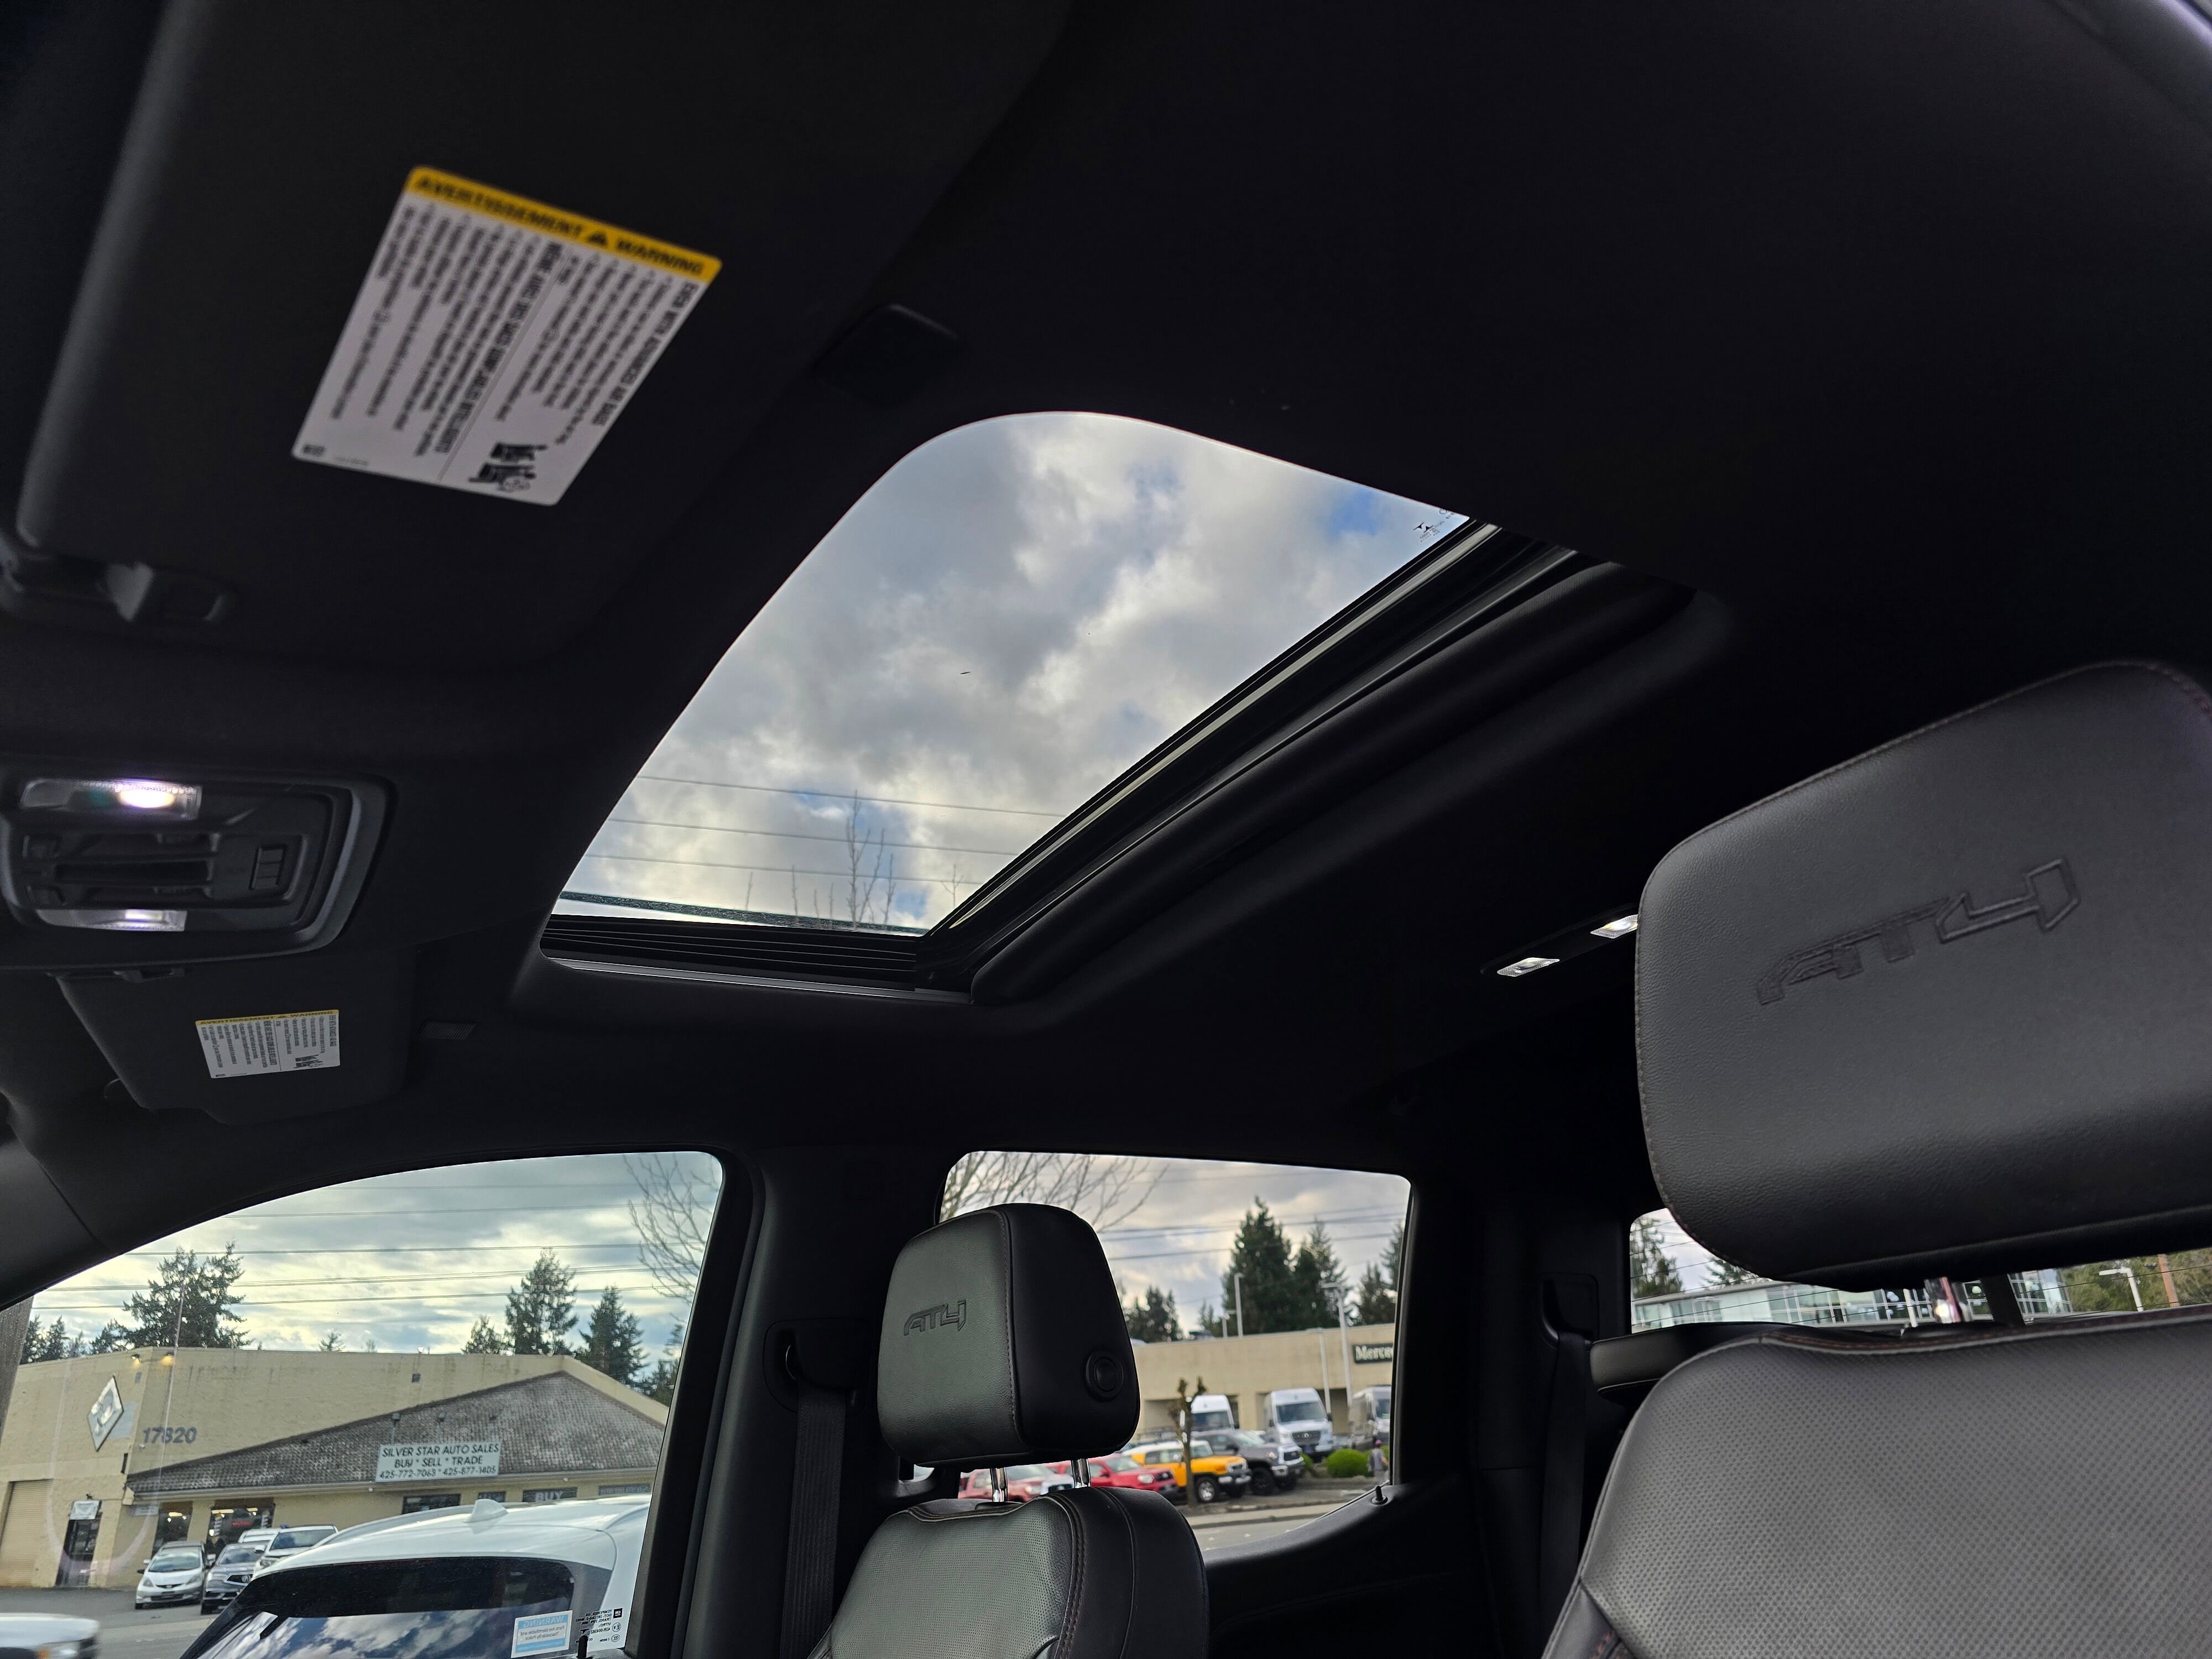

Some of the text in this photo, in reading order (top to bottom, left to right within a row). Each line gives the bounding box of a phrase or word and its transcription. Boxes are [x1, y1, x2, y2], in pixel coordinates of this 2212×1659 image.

[615, 237, 704, 276] WARNING
[200, 1010, 334, 1025] AVERTISSEMENT WARNING
[904, 1299, 966, 1336] AT4
[1355, 1345, 1394, 1360] Merce
[143, 1426, 198, 1444] 17820
[382, 1443, 499, 1458] SILVER STAR AUTO SALES
[394, 1455, 483, 1469] BUY SELL TRADE
[534, 1491, 564, 1502] BUY
